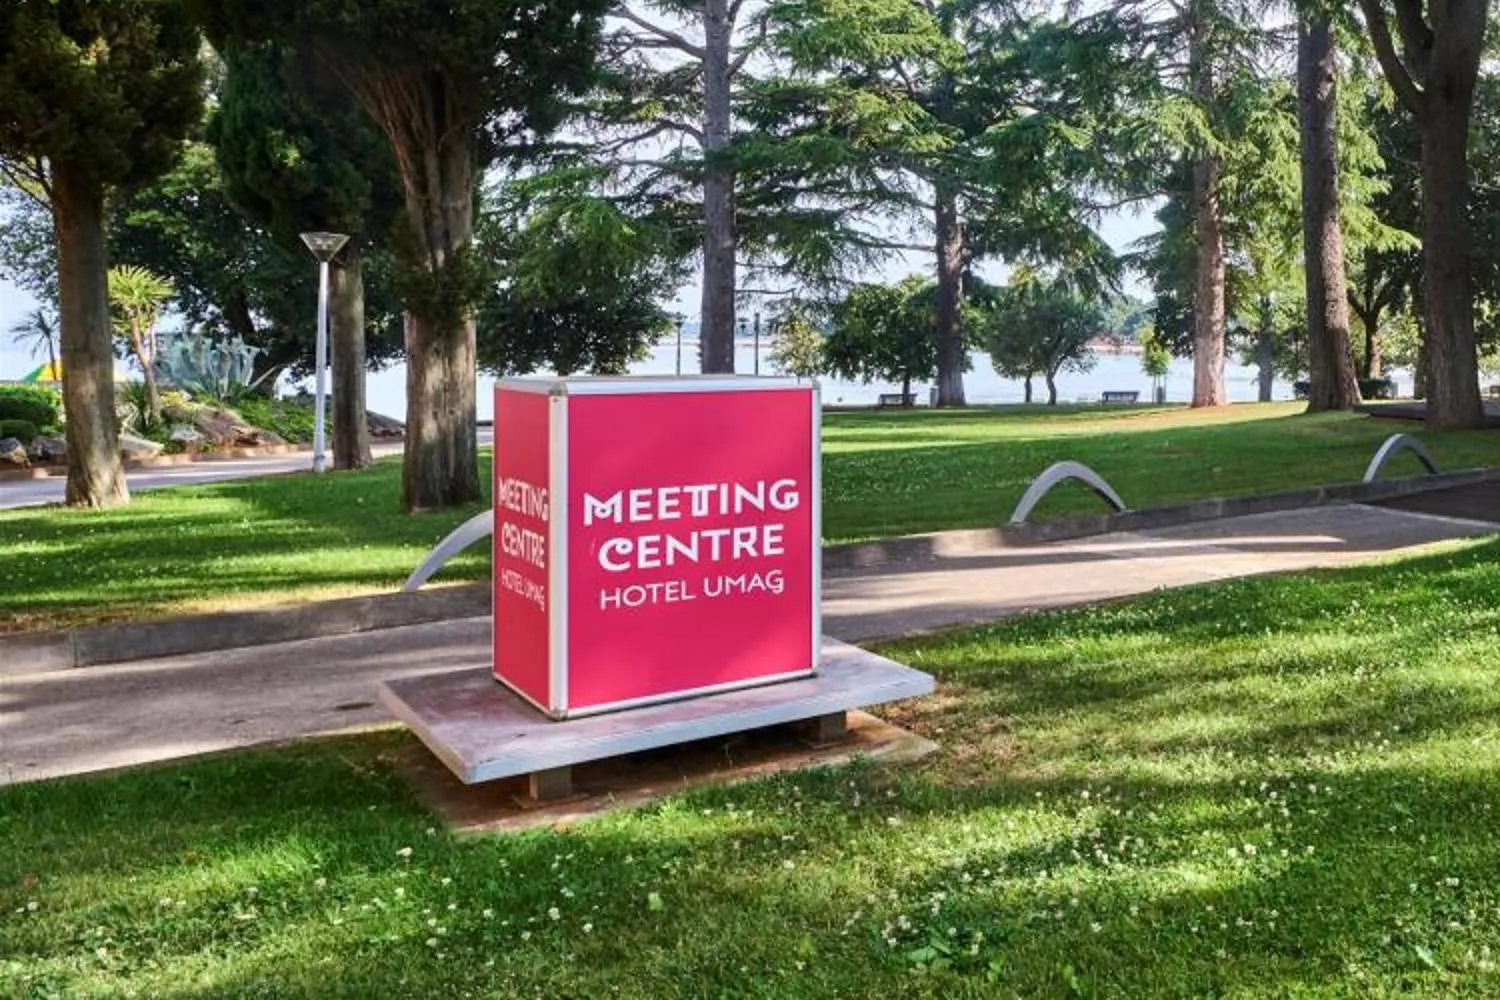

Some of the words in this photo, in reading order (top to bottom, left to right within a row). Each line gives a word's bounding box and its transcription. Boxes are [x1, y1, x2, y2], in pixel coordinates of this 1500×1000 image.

[498, 476, 548, 521] MEETING
[583, 479, 800, 526] MEETING
[501, 521, 545, 568] CENTRE
[597, 523, 785, 571] CENTRE
[501, 567, 525, 596] HOTEL
[524, 577, 545, 613] UMAG
[600, 579, 696, 611] HOTEL
[703, 568, 785, 597] UMAG
